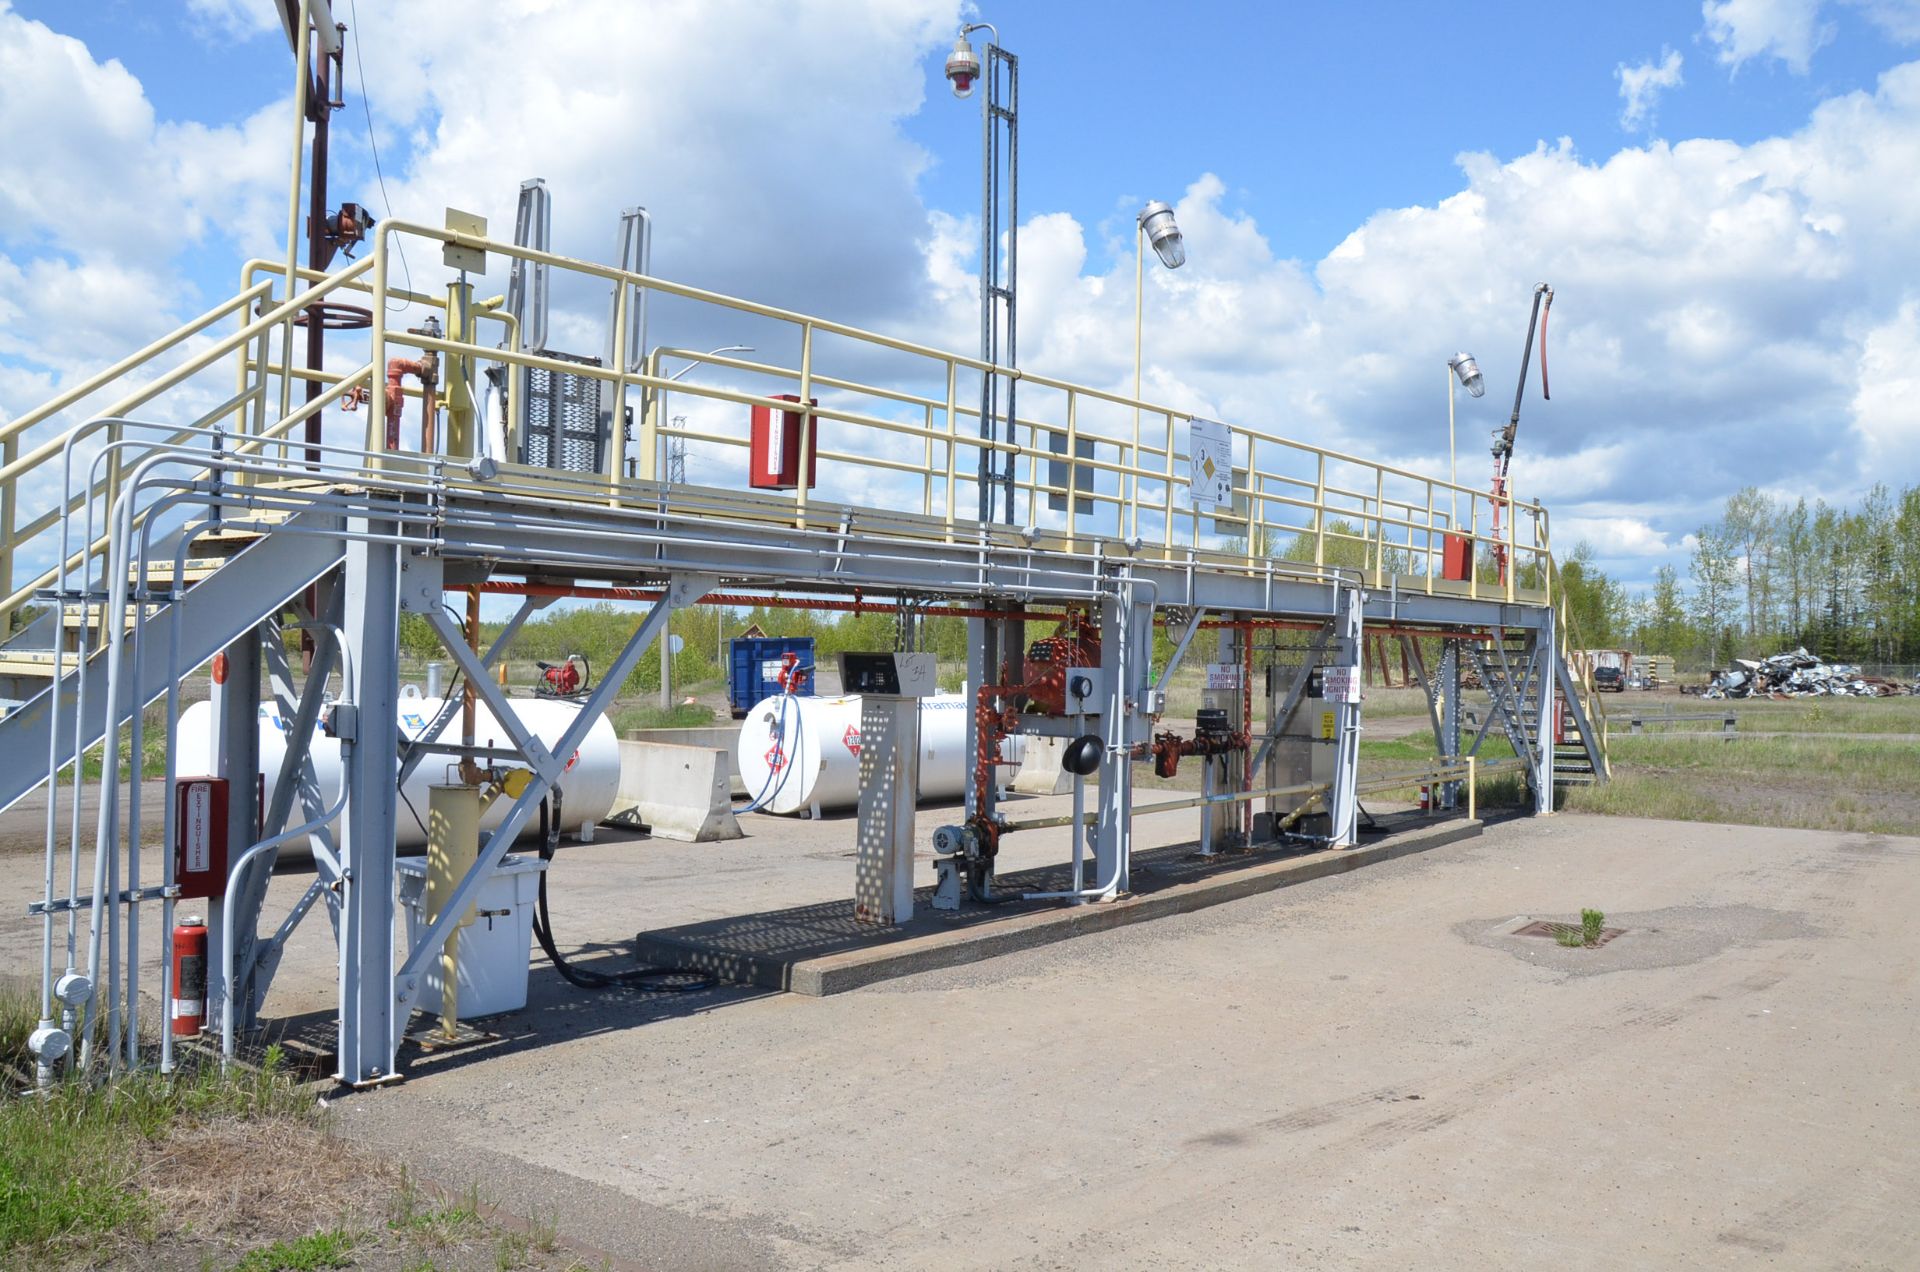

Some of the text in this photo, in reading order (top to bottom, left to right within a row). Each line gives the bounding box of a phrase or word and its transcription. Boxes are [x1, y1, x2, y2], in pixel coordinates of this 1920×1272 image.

[1201, 448, 1205, 461] 3
[1221, 665, 1231, 673] NO
[1336, 668, 1347, 676] NO
[1325, 676, 1357, 684] SMOKING
[1327, 685, 1356, 693] IGNITION
[191, 785, 208, 793] FIRE
